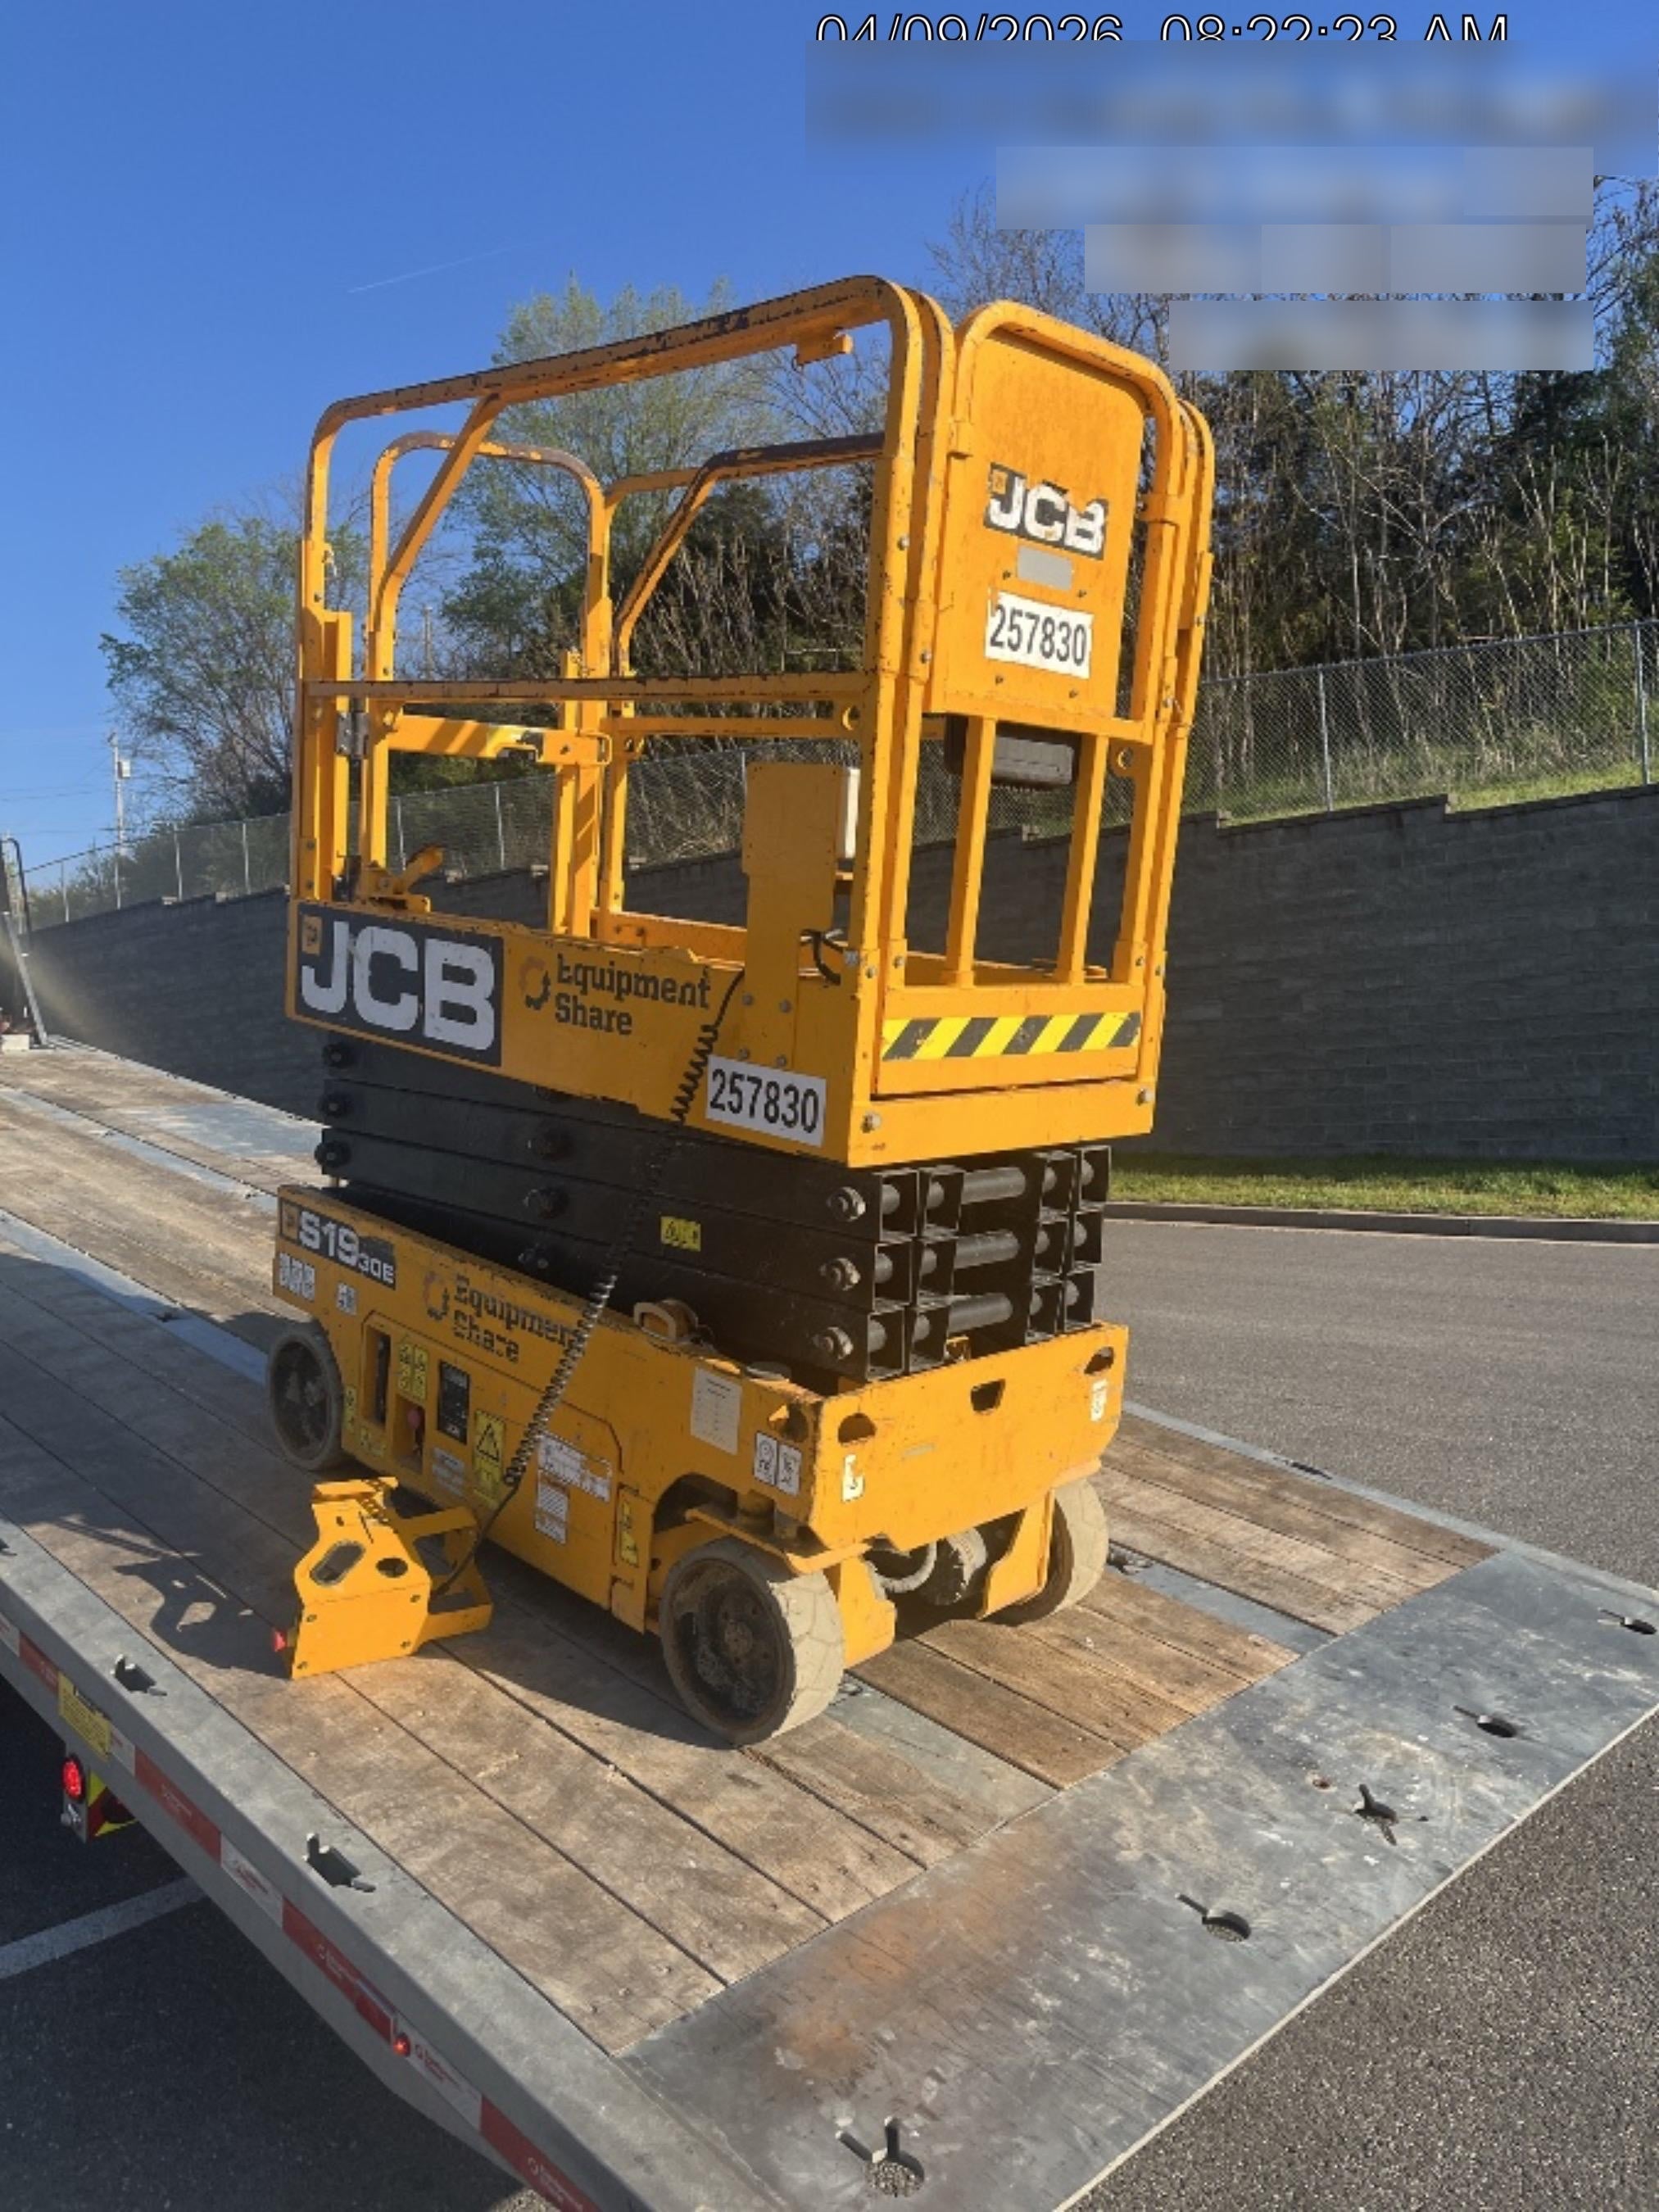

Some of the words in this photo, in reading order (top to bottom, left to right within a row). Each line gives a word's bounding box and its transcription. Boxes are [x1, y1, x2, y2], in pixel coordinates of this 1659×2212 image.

[989, 476, 1106, 554] JCB
[989, 604, 1087, 666] 257830
[301, 920, 495, 1051] JCB
[554, 991, 633, 1036] Share
[709, 1067, 818, 1133] 257830
[452, 1309, 520, 1363] Share
